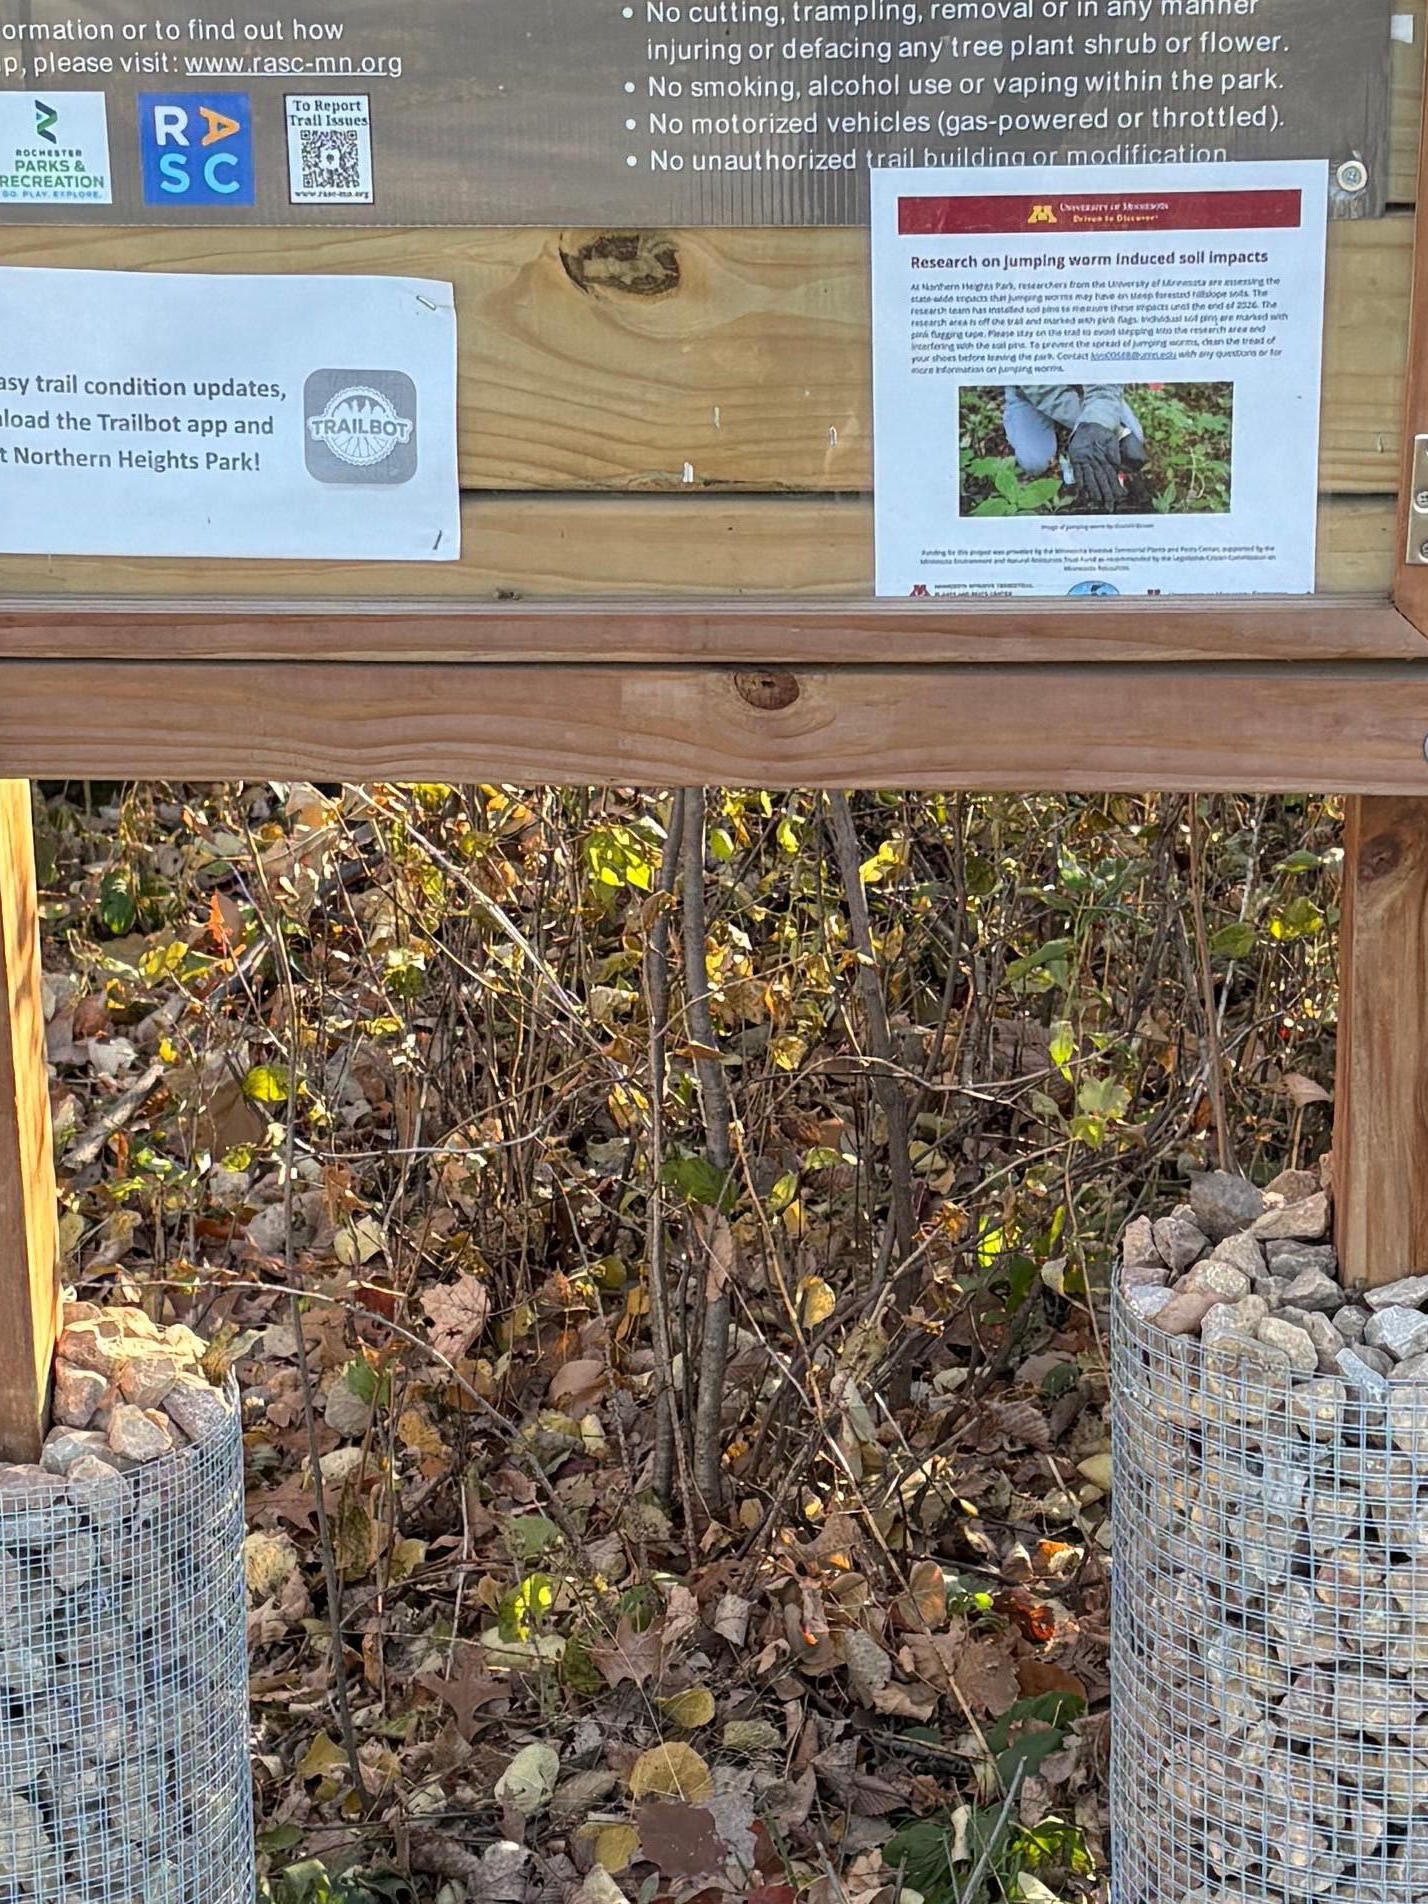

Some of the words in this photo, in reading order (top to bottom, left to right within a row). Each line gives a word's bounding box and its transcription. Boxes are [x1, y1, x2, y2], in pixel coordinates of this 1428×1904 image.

[33, 53, 114, 76] please
[119, 51, 178, 73] visit:
[184, 56, 402, 77] www.rasc-mn.org
[648, 75, 683, 97] No
[690, 76, 801, 102] smoking,
[808, 74, 899, 97] alcohol
[908, 78, 952, 95] use
[959, 77, 985, 94] or
[993, 73, 1078, 98] vaping
[1084, 70, 1162, 92] within
[1171, 69, 1214, 91] the
[1221, 69, 1283, 94] park.
[293, 100, 310, 111] To
[314, 100, 361, 114] Report
[290, 114, 323, 126] Trail
[326, 114, 368, 126] Issues
[649, 113, 683, 134] No
[691, 113, 818, 134] motorized
[826, 111, 931, 133] vehicles
[937, 111, 1108, 136] (gas-powered
[1117, 111, 1144, 129] or
[1152, 105, 1284, 130] throttled).
[15, 149, 82, 157] ROCHESTER
[15, 160, 70, 172] PARKS
[74, 160, 86, 172] &
[0, 175, 104, 188] RECREATION
[910, 256, 978, 269] Research
[981, 257, 1001, 268] on
[1003, 254, 1066, 271] jumping
[1068, 255, 1112, 266] worm
[1115, 252, 1176, 266] induced
[1179, 250, 1205, 265] soil
[1208, 251, 1269, 266] impacts
[35, 374, 78, 394] trail
[84, 377, 187, 396] condition
[193, 379, 286, 400] updates,
[56, 411, 92, 431] the
[96, 413, 182, 433] Trailbot
[187, 419, 228, 438] app
[234, 416, 274, 435] and
[310, 418, 408, 436] TRAILBOT
[13, 447, 112, 468] Northern
[118, 450, 199, 473] Heights
[205, 451, 260, 472] Park!
